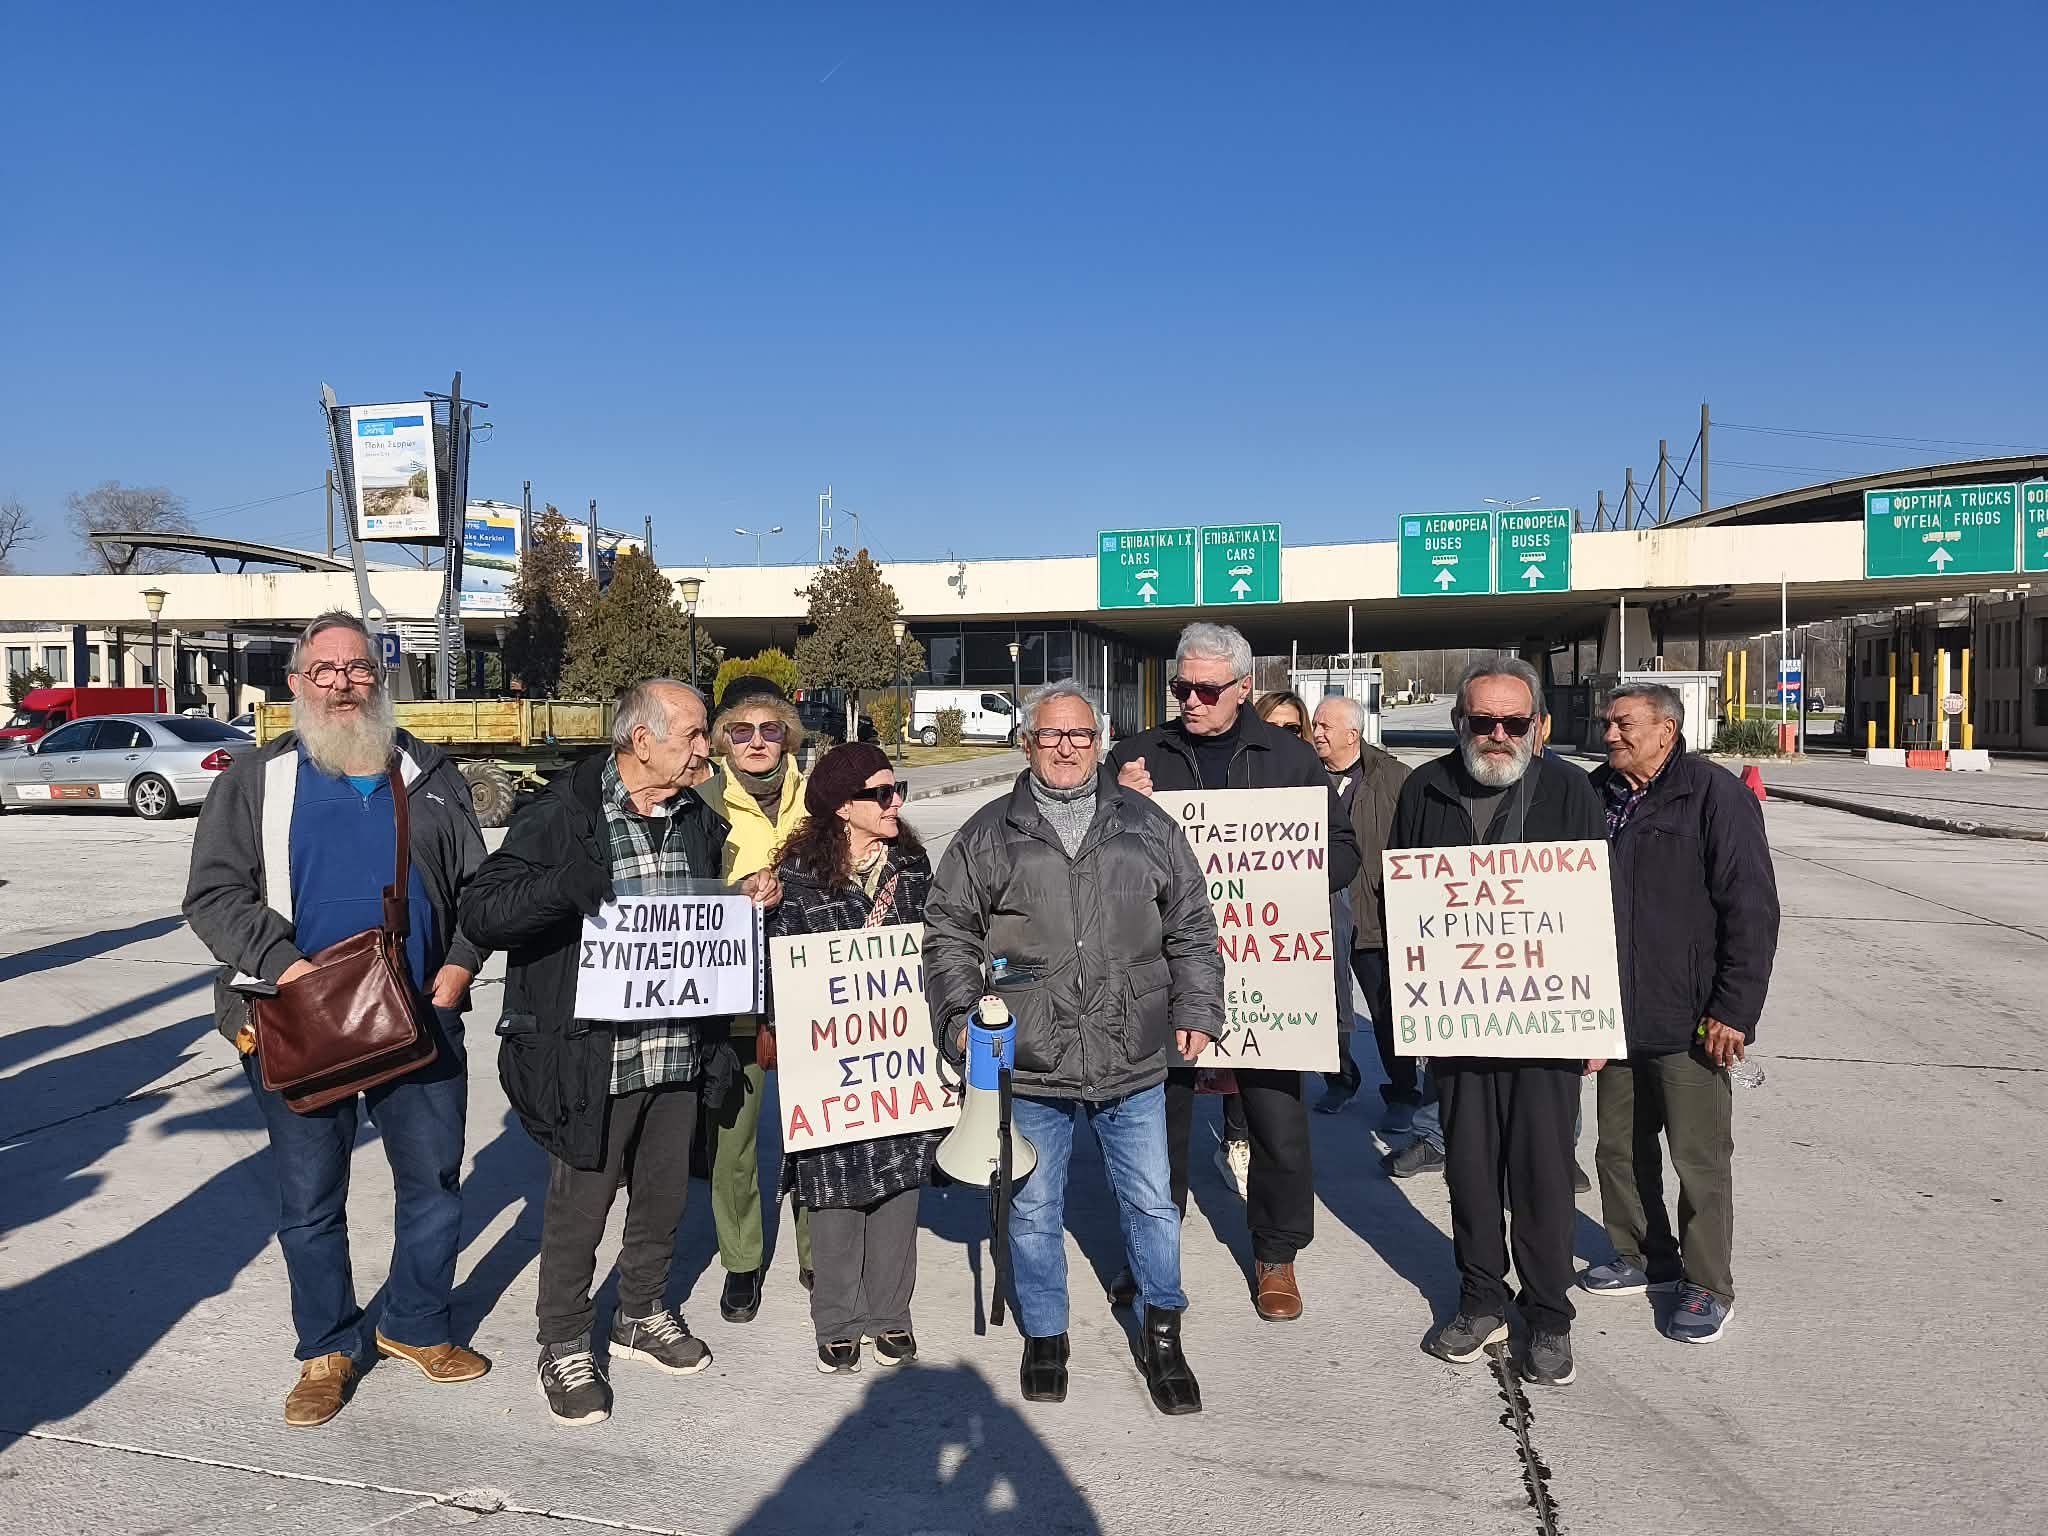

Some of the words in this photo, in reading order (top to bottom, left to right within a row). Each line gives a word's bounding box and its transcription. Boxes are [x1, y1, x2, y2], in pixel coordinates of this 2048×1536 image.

[1893, 493, 1953, 510] ΦΟΡΤΗΓΑ
[1961, 491, 2012, 507] TRUCKS
[1425, 517, 1489, 533] ΛΕΩΦΟΡΕΙΑ
[1501, 514, 1567, 531] ΛΕΩΦΟΡΕΙΑ
[1893, 513, 1941, 529] ΨΥΓΕΙΑ
[1954, 511, 2001, 527] FRIGOS
[464, 532, 477, 541] ake
[1120, 534, 1174, 549] ΕΠΙΒΑΤΙΚΑ
[1204, 530, 1260, 545] ΕΠΙΒΑΤΙΚΑ
[1425, 536, 1462, 551] BUSES
[1511, 533, 1551, 548] BUSES
[1120, 552, 1151, 566] CARS
[1226, 547, 1256, 561] CARS
[382, 638, 396, 667] P
[1944, 698, 1963, 709] STOP
[1182, 802, 1205, 821] ΟΙ
[1183, 821, 1320, 844] ΤΑΞΙΟΥΧΟΙ
[1205, 847, 1325, 875] ΛΙΑΖΟΥΝ
[1388, 853, 1455, 881] ΣΤΑ
[1469, 846, 1598, 877] ΜΠΛΟΚΑ
[1210, 878, 1245, 900] ΟΝ
[1443, 878, 1525, 908] ΣΑΣ
[614, 902, 724, 933] ΣΩΜΑΤΕΙΟ
[1211, 901, 1280, 929] ΑΙΟ
[1418, 911, 1565, 939] ΚΡΙΝΕΤΑΙ
[580, 938, 747, 971] ΣΥΝΤΑΞΙΟΥΧΩΝ
[789, 944, 808, 969] Η
[828, 932, 920, 964] ΕΛΠΙΔ
[1217, 933, 1261, 963] ΝΑ
[1268, 930, 1333, 962] ΣΑΣ
[1405, 945, 1426, 972] Η
[1455, 939, 1545, 970] ΖΩΗ
[622, 977, 709, 1009] Ι.Κ.Α.
[828, 964, 925, 1006] ΕΙΝΑΙ
[1227, 977, 1263, 1004] είο
[1403, 974, 1592, 1009] ΧΙΛΙΑΔΩΝ
[810, 1005, 908, 1052] ΜΟΝΟ
[1224, 1004, 1318, 1033] ξιούχων
[1399, 1007, 1616, 1044] ΒΙΟΠΑΛΑΙΣΤΩΝ
[1214, 1027, 1262, 1057] ΚΑ
[838, 1046, 926, 1088] ΣΤΟΝ
